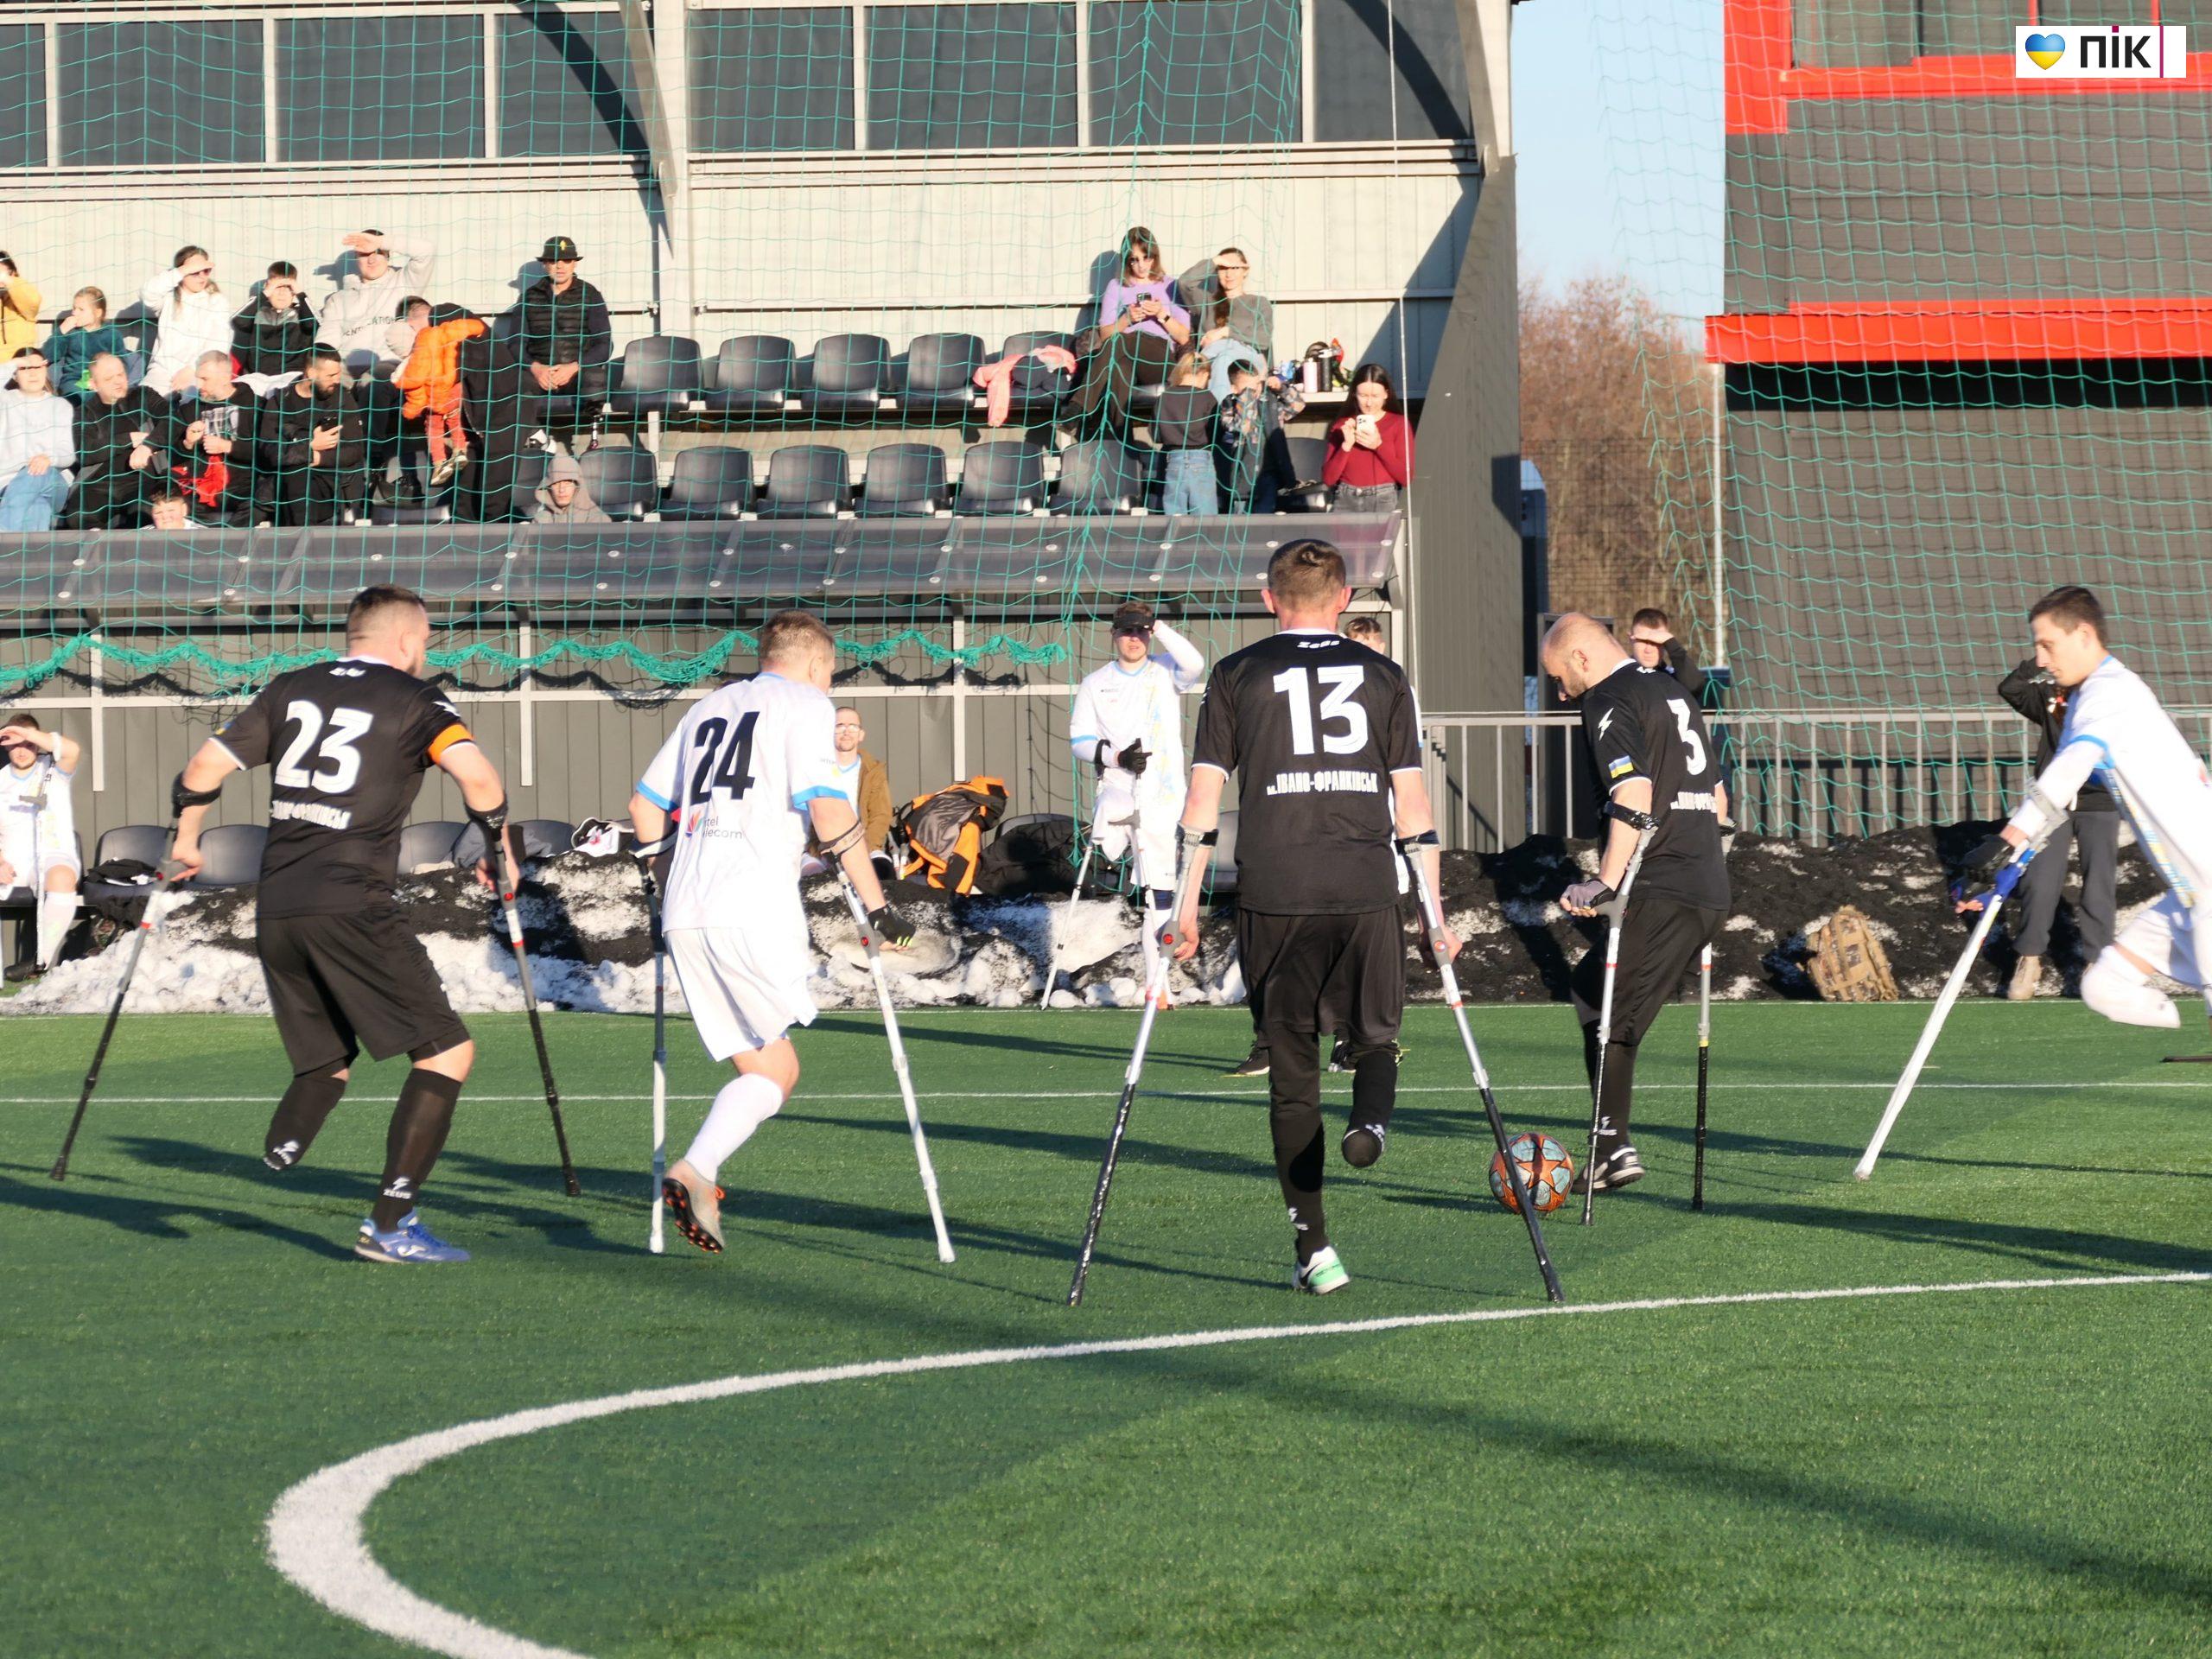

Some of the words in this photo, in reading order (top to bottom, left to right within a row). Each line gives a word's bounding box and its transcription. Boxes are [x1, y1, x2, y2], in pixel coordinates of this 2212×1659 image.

[274, 700, 373, 793] 23
[1273, 665, 1369, 755] 13
[1666, 698, 1707, 776] 3
[690, 711, 760, 806] 24
